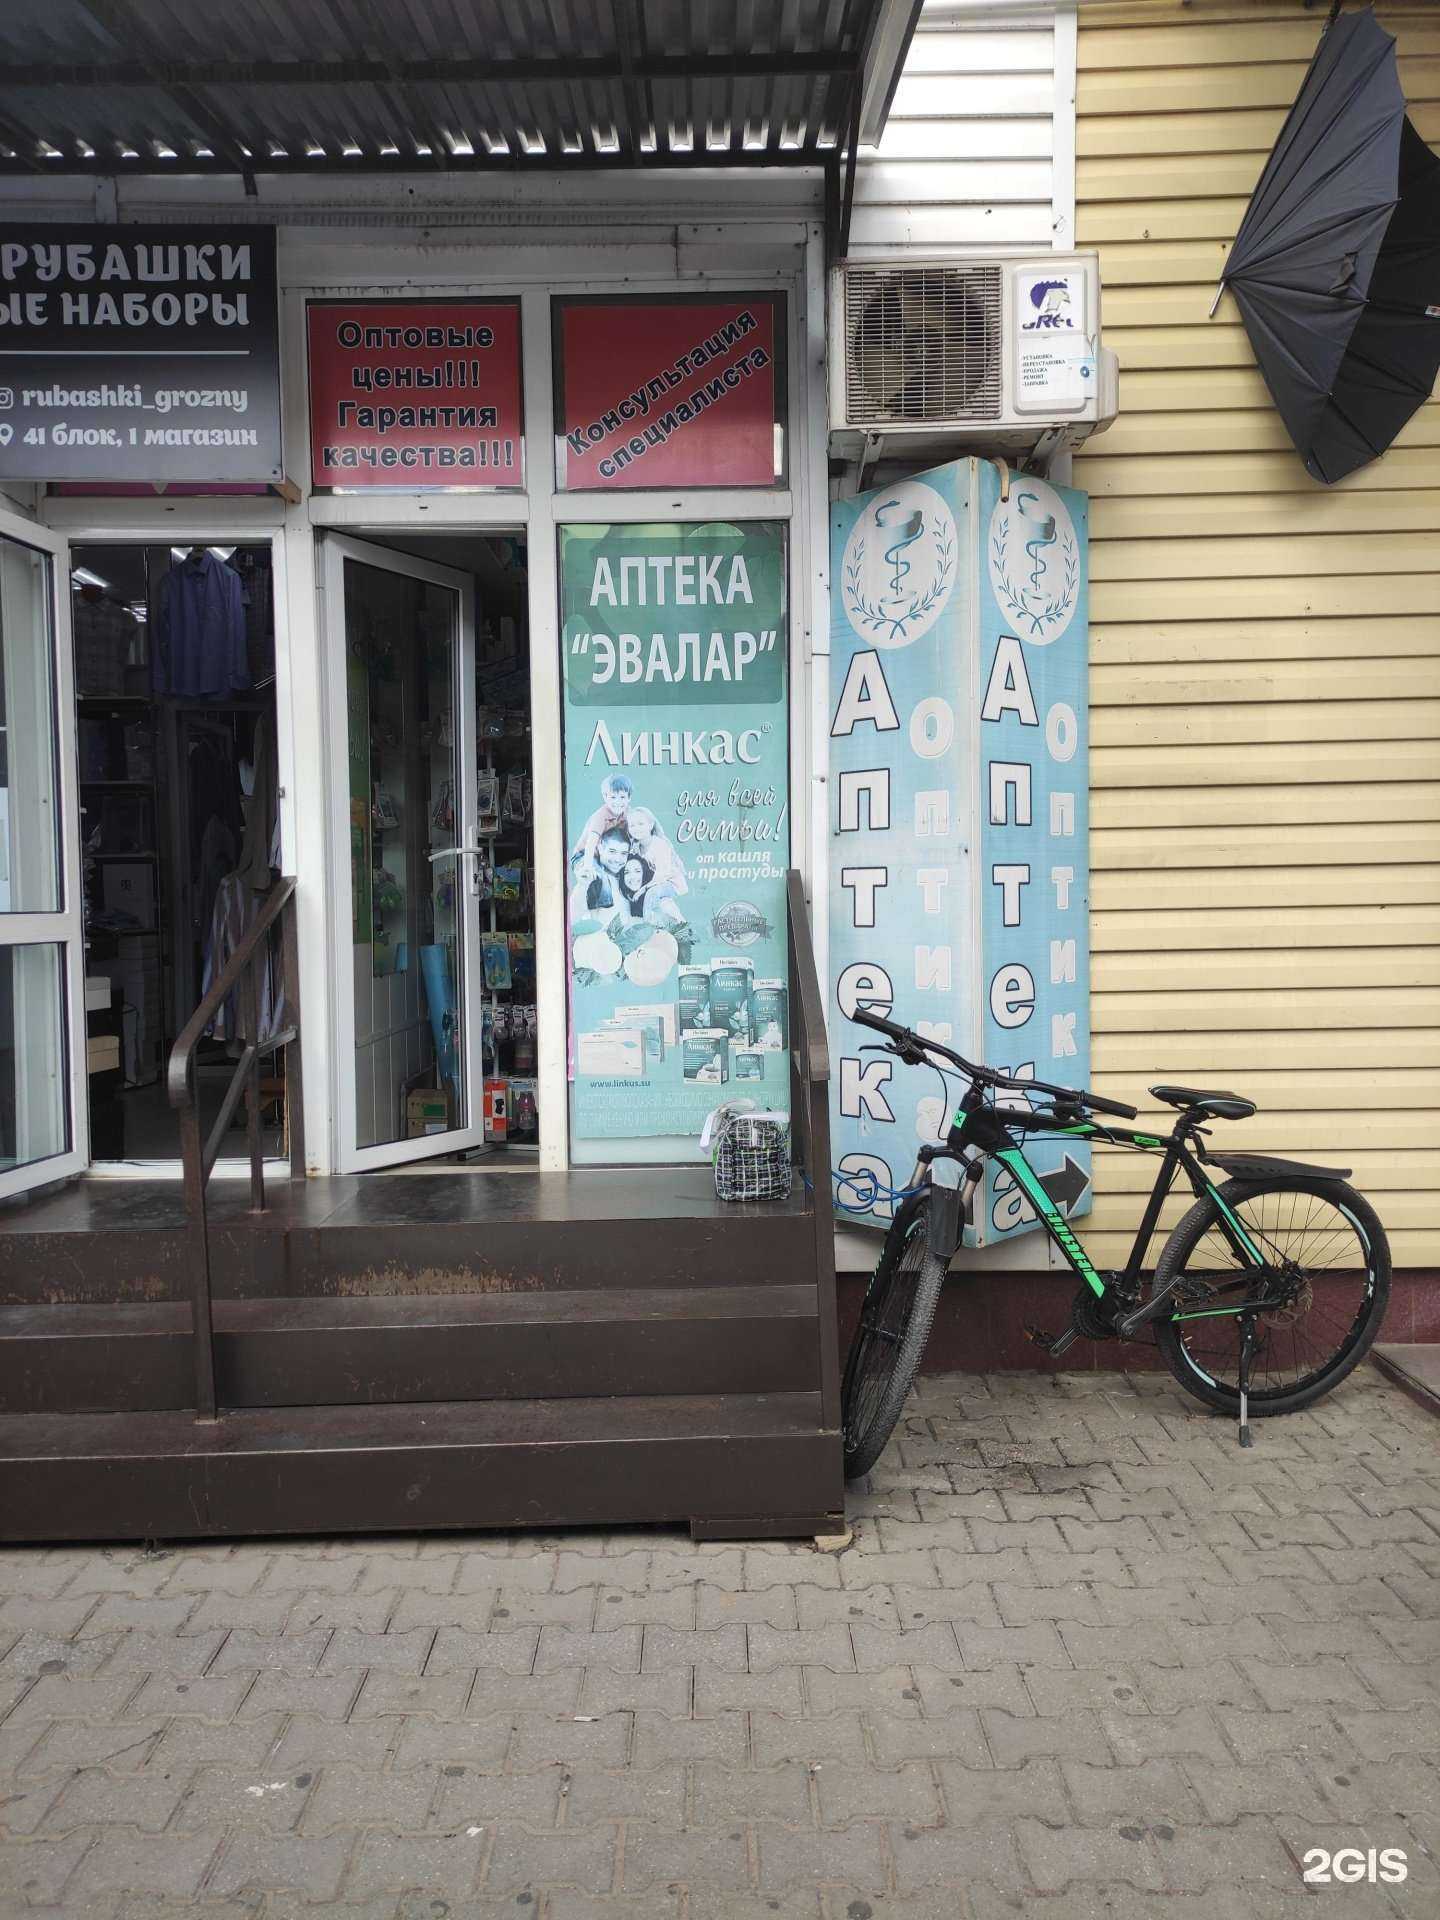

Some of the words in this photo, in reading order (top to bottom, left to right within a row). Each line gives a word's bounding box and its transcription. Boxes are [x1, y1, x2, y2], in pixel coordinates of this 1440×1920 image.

[1, 243, 251, 282] РУБАШКИ
[60, 293, 250, 326] НАБОРЫ
[336, 320, 495, 349] Оптовые
[351, 360, 480, 392] цены!!!
[566, 311, 758, 455] Консультация
[22, 385, 248, 413] rubashki_grozny
[598, 347, 772, 478] специалиста
[337, 400, 497, 434] Гарантия
[23, 427, 46, 445] 41
[52, 422, 123, 447] блок,
[129, 427, 137, 445] 1
[144, 427, 258, 447] магазин
[322, 440, 514, 468] качества!!!
[589, 555, 754, 607] АПТЕКА
[676, 789, 720, 816] для
[728, 777, 777, 808] всей
[677, 801, 787, 843] семьи!
[696, 855, 714, 864] от
[718, 851, 772, 863] кашля
[698, 862, 784, 883] простуды
[830, 648, 901, 1218] Аптека
